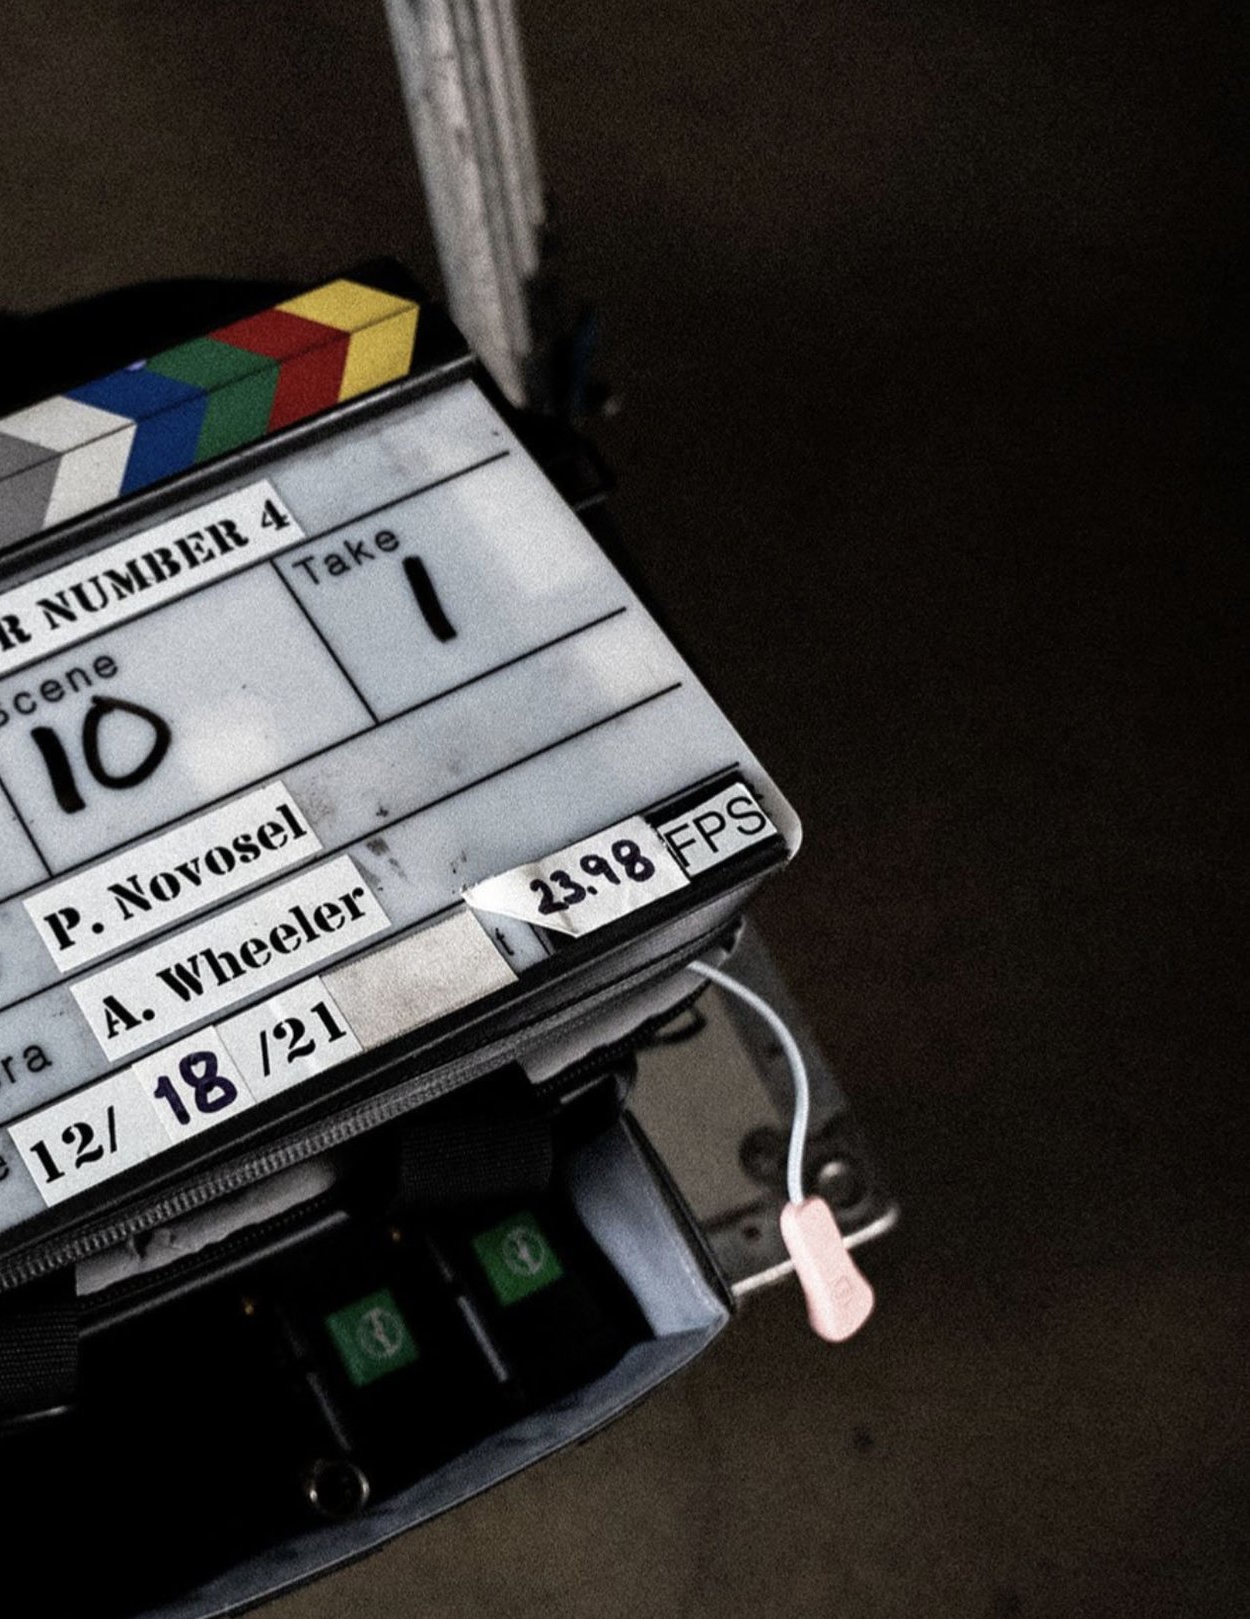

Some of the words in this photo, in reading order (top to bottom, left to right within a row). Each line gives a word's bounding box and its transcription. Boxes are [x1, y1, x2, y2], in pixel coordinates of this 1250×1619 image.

[36, 518, 249, 631] NUMBER
[260, 499, 290, 531] 4
[292, 527, 400, 588] Take
[402, 557, 458, 642] 1
[31, 695, 172, 814] 10
[664, 795, 767, 868] FPS
[43, 906, 105, 951] P.
[107, 804, 306, 920] Novosel
[530, 840, 655, 915] 23.98
[101, 995, 155, 1040] A.
[156, 886, 366, 1003] Wheeler
[154, 1050, 238, 1125] 18
